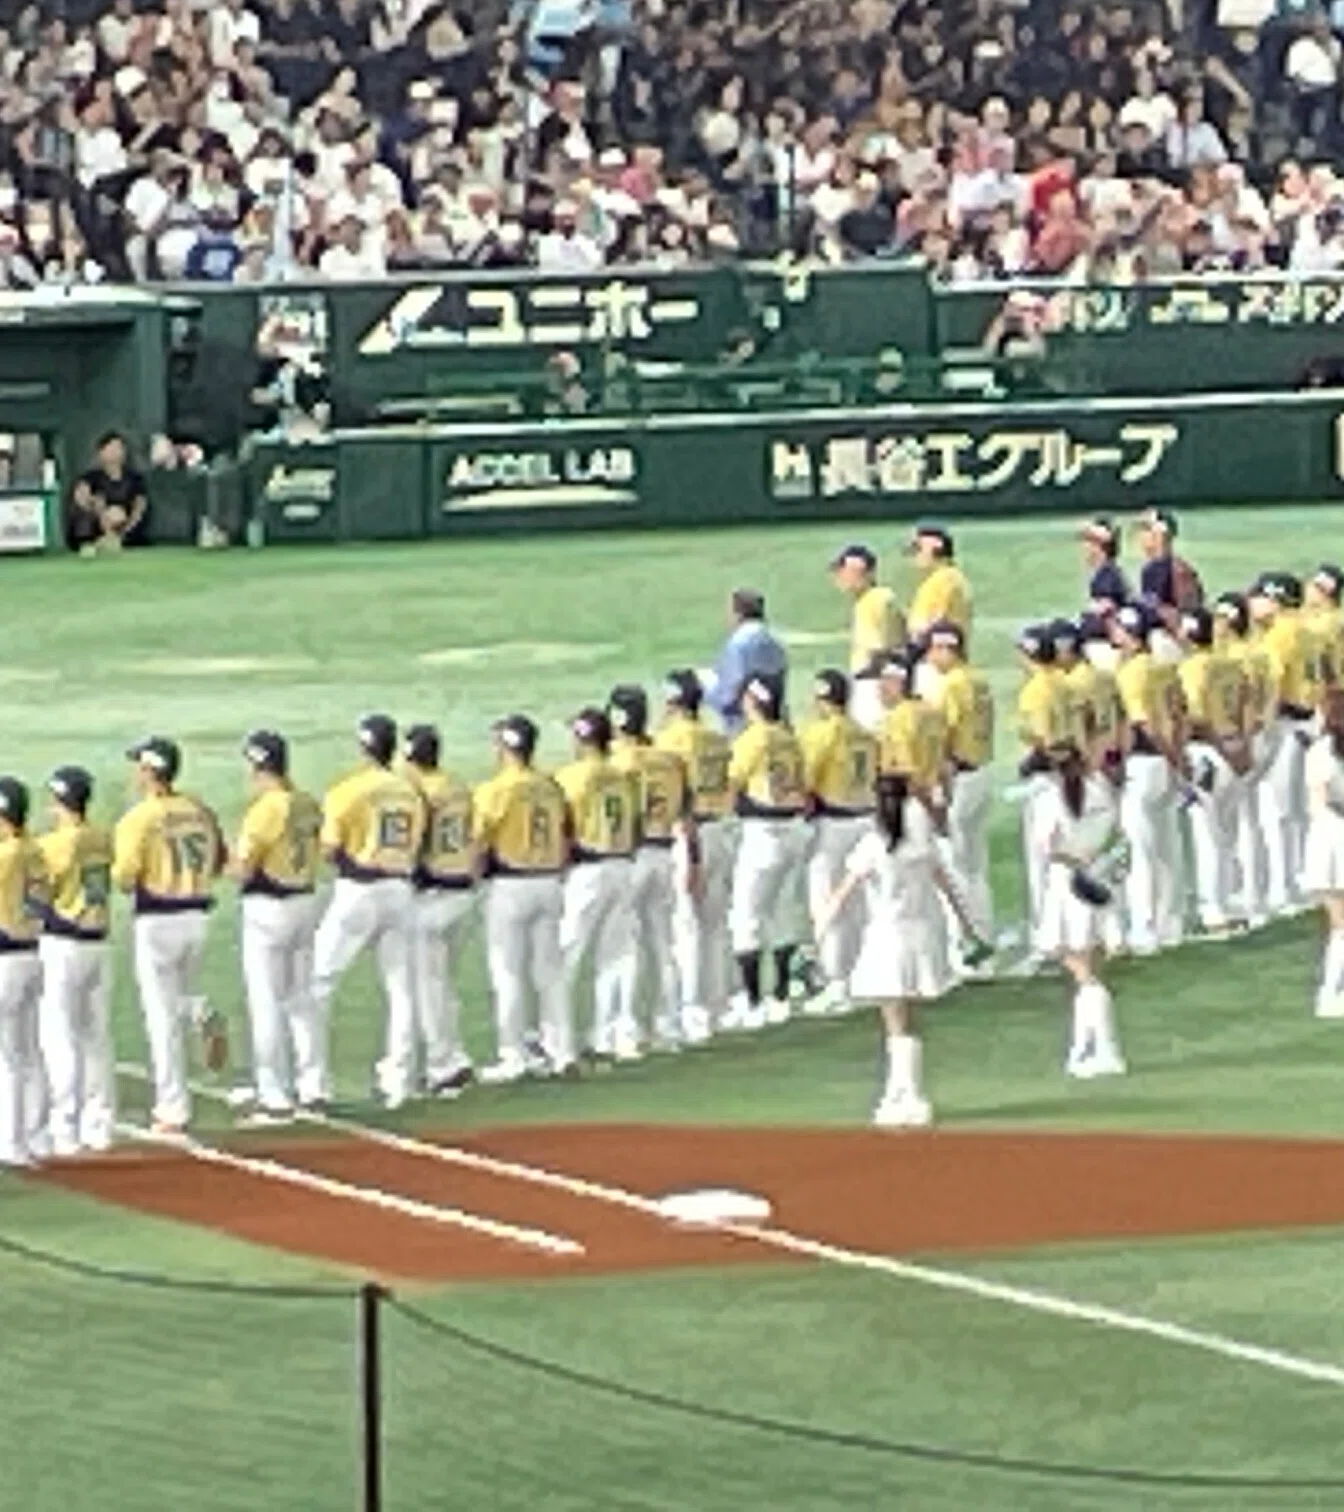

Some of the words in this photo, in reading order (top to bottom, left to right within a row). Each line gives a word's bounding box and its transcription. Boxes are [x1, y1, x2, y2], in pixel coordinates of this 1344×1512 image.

[467, 281, 698, 346] ユニホー
[447, 452, 560, 486] ACCEL
[564, 448, 636, 482] LAB
[821, 423, 1179, 496] 長谷工グループ
